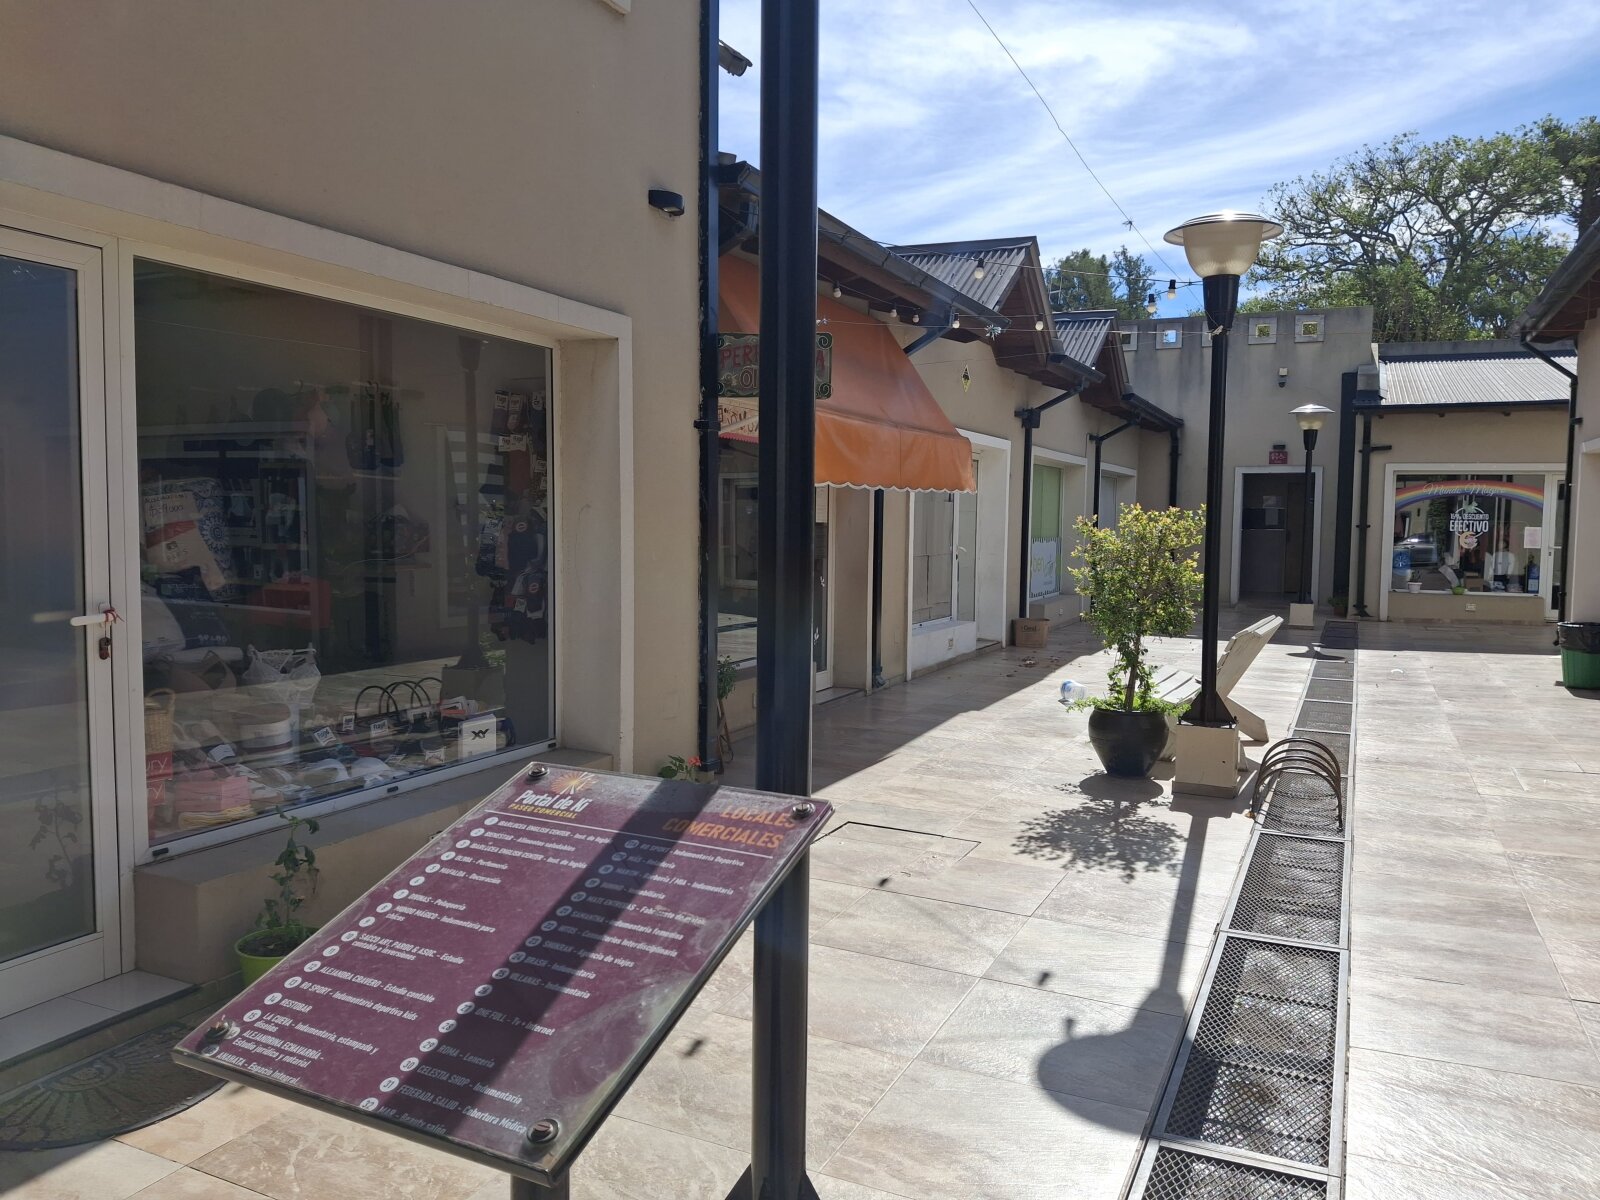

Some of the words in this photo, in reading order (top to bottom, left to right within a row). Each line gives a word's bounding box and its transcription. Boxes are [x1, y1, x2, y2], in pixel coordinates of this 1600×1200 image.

[1449, 520, 1489, 533] EFECTIVO
[1463, 513, 1490, 521] DESCUENTO
[508, 803, 535, 811] PASEO
[533, 807, 578, 818] COMERCIAL
[515, 790, 559, 806] Portal
[553, 796, 577, 809] de
[570, 798, 592, 811] Ki
[662, 817, 785, 848] COMERCIALES
[545, 841, 577, 851] saludables
[674, 849, 715, 860] Indumentaria
[714, 856, 745, 866] Deportiva
[691, 881, 734, 894] Indumentaria
[394, 905, 415, 913] MUNDO
[440, 915, 482, 929] Indumentaria
[479, 925, 496, 933] para
[351, 941, 377, 950] contable
[381, 948, 418, 960] inversiones
[359, 933, 380, 942] SACCO
[391, 941, 414, 950] PARDO
[440, 953, 466, 964] Estudio
[551, 963, 597, 979] Indumentaria
[613, 957, 635, 968] viajes
[319, 966, 355, 979] ALEJANDRA
[352, 975, 382, 987] CRAVERO
[384, 984, 409, 994] Estudio
[406, 990, 436, 1002] contable
[545, 982, 592, 998] Indumentaria
[280, 999, 312, 1012] RESTOBAR
[309, 984, 330, 994] SPORT
[332, 991, 374, 1007] Indumentaria
[372, 1002, 404, 1016] deportiva
[402, 1011, 419, 1019] kids
[272, 1015, 293, 1025] CUEVA
[335, 1036, 374, 1052] estampado
[232, 1038, 257, 1049] Estudio
[282, 1054, 311, 1067] notarial
[242, 1030, 284, 1046] ALEJANDRINA
[282, 1041, 323, 1058] ECHAVARRÍA
[438, 1045, 460, 1056] ROMA
[216, 1052, 246, 1065] ANAHATA
[247, 1063, 274, 1075] Espacio
[272, 1070, 300, 1083] Integral
[417, 1065, 450, 1079] CELESTIA
[447, 1075, 469, 1086] SHOP
[472, 1083, 524, 1104] Indumentaria
[397, 1085, 435, 1101] FEDERADA
[433, 1096, 458, 1109] SALUD
[462, 1106, 501, 1124] Cobertura
[499, 1116, 530, 1133] Médica
